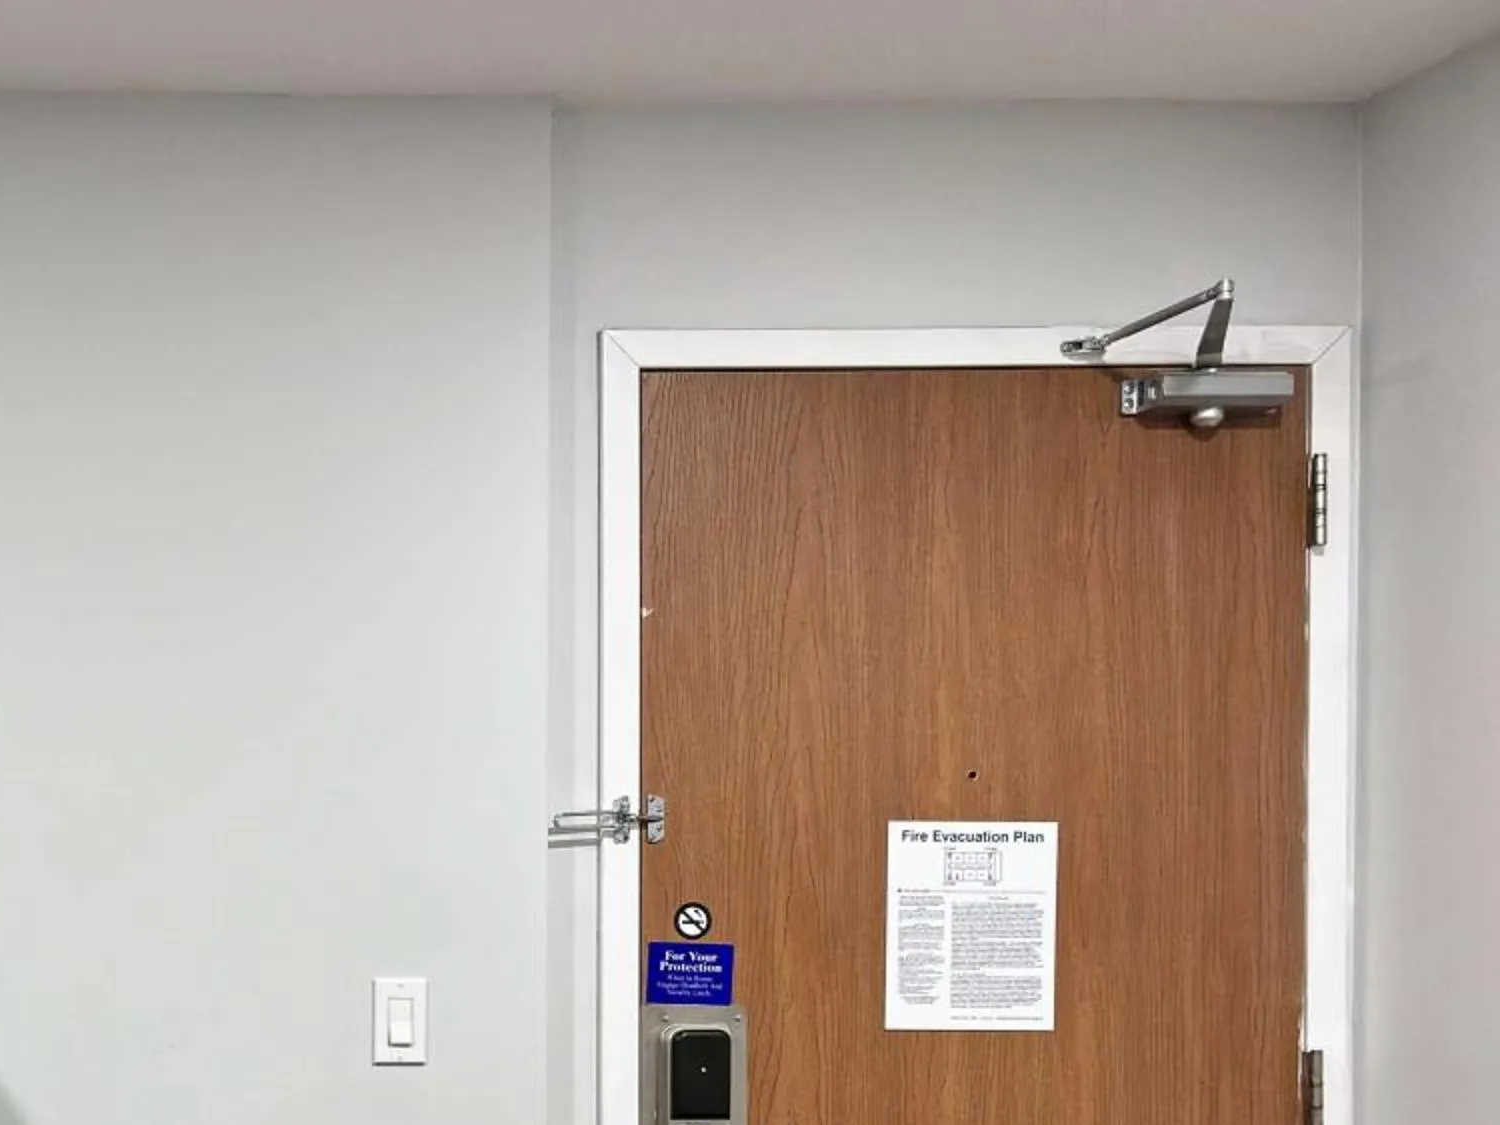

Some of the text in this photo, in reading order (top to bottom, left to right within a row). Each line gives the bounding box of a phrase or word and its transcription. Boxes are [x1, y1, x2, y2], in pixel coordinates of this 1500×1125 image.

[901, 829, 1045, 844] Fire Evacuation Plan
[665, 950, 718, 962] For Your
[659, 961, 723, 973] Protection
